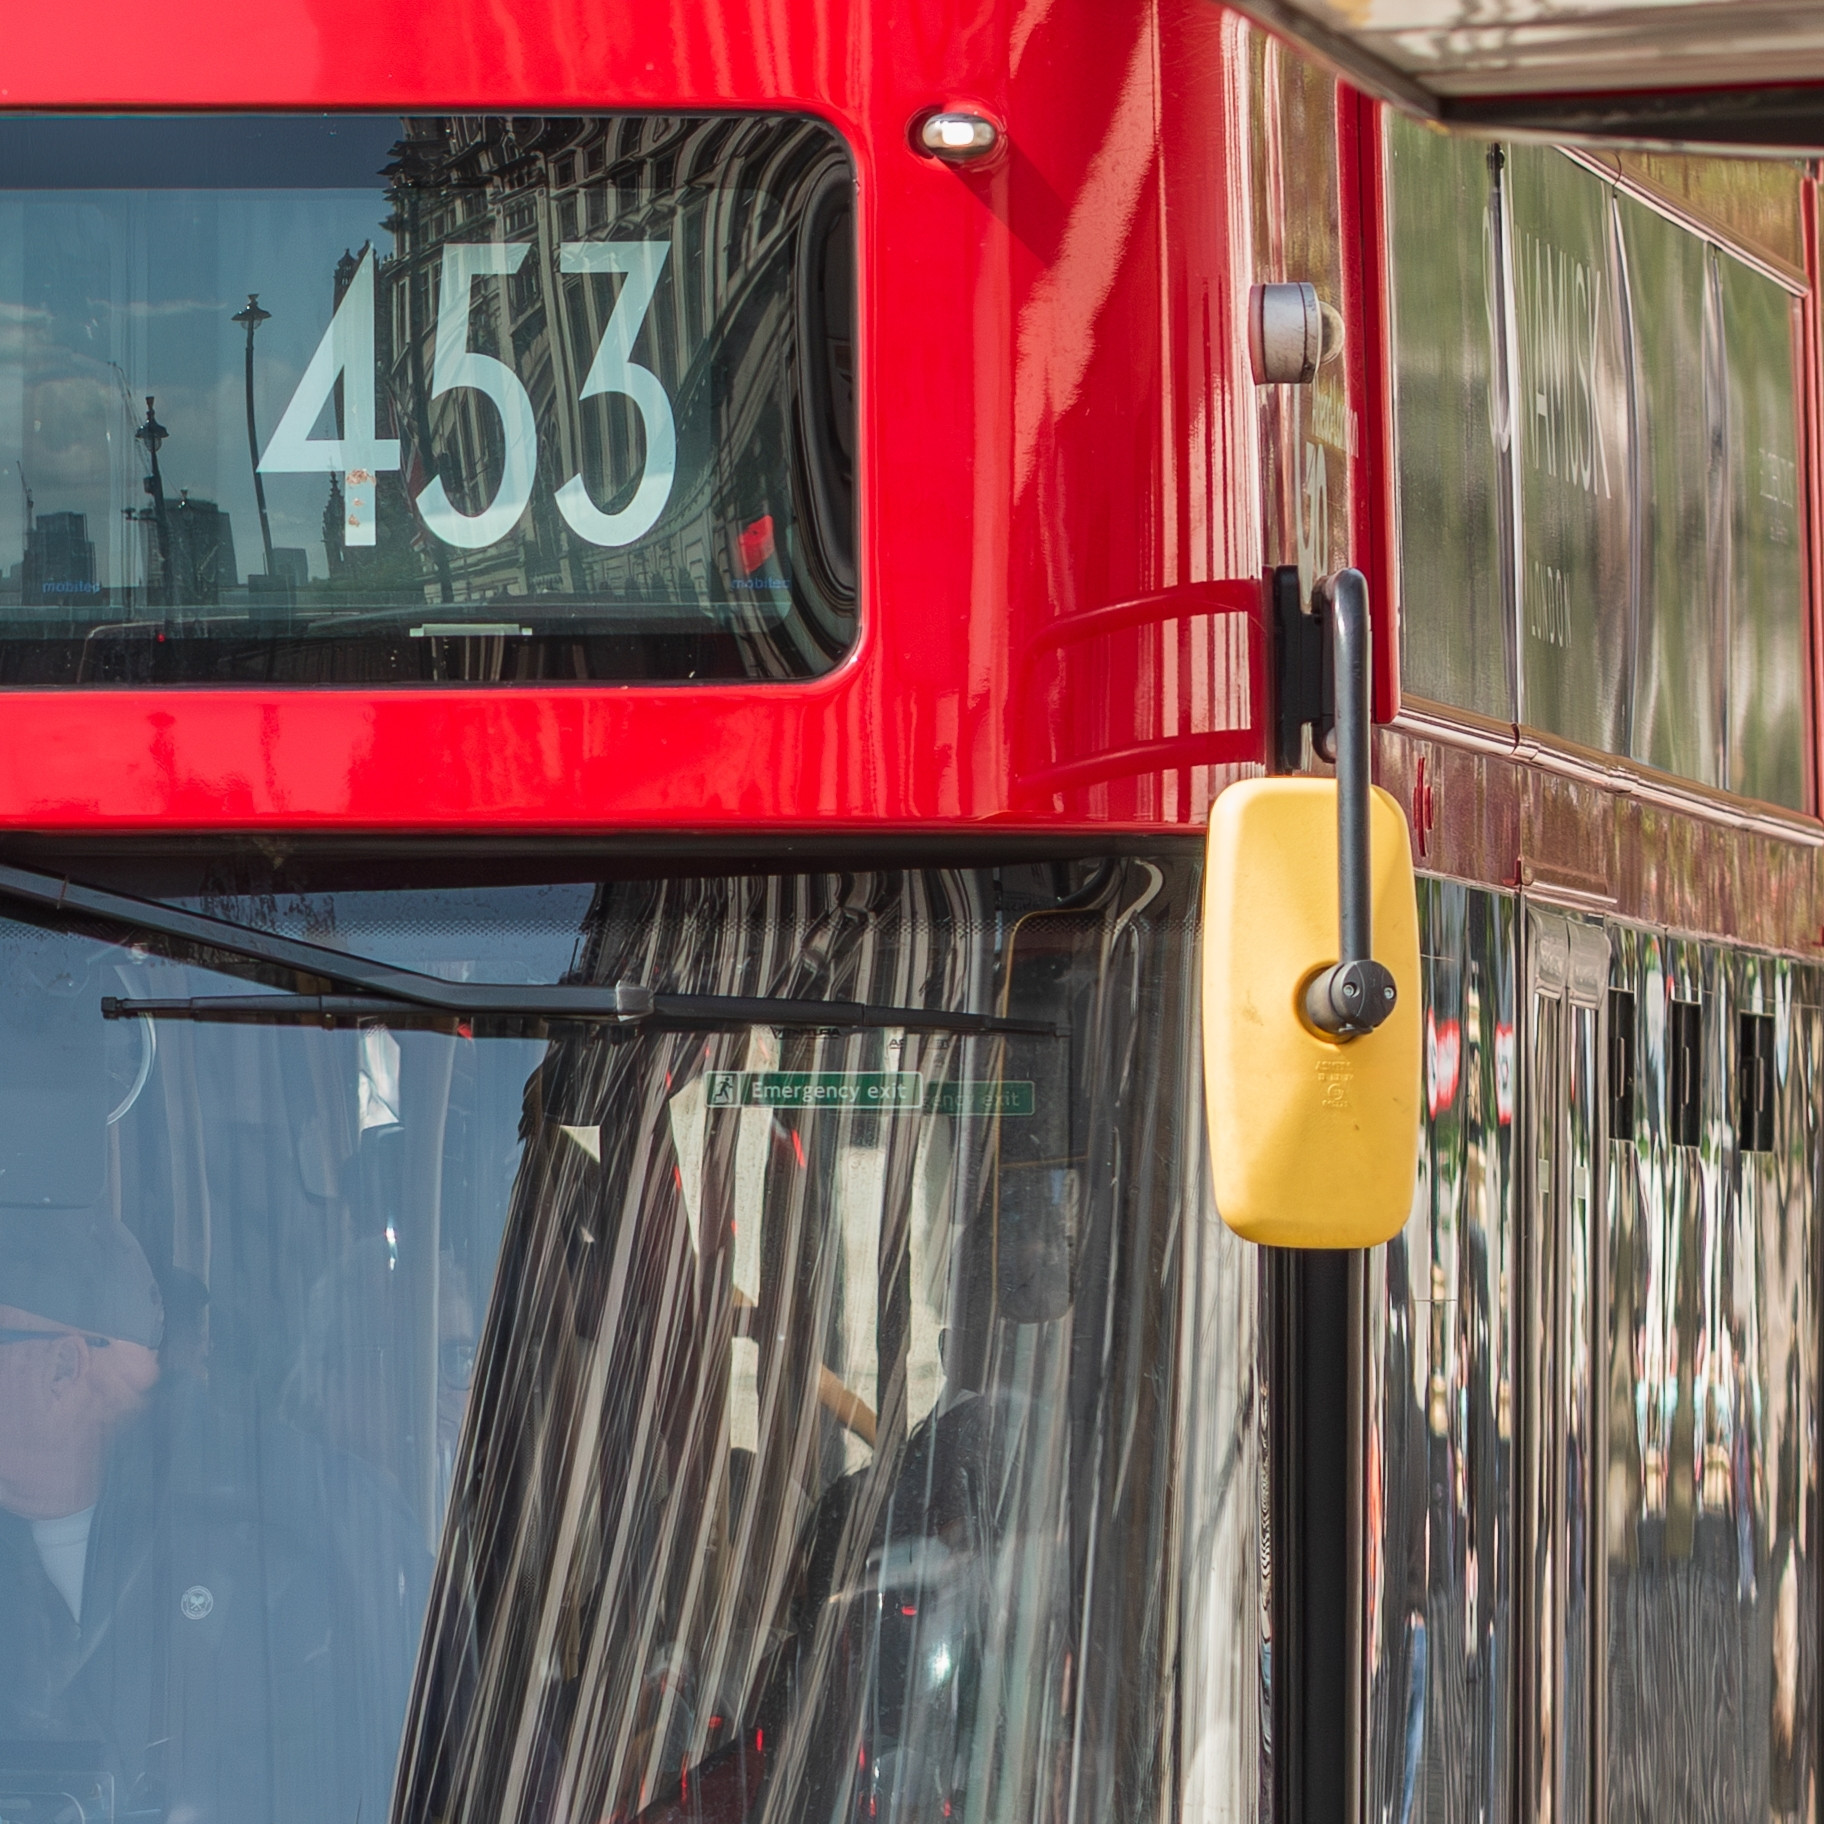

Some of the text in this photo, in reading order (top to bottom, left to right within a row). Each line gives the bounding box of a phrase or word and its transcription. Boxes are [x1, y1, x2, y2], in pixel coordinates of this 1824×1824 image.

[256, 238, 676, 548] 453
[1531, 560, 1571, 648] LONDON
[752, 1080, 907, 1103] Emergency exit
